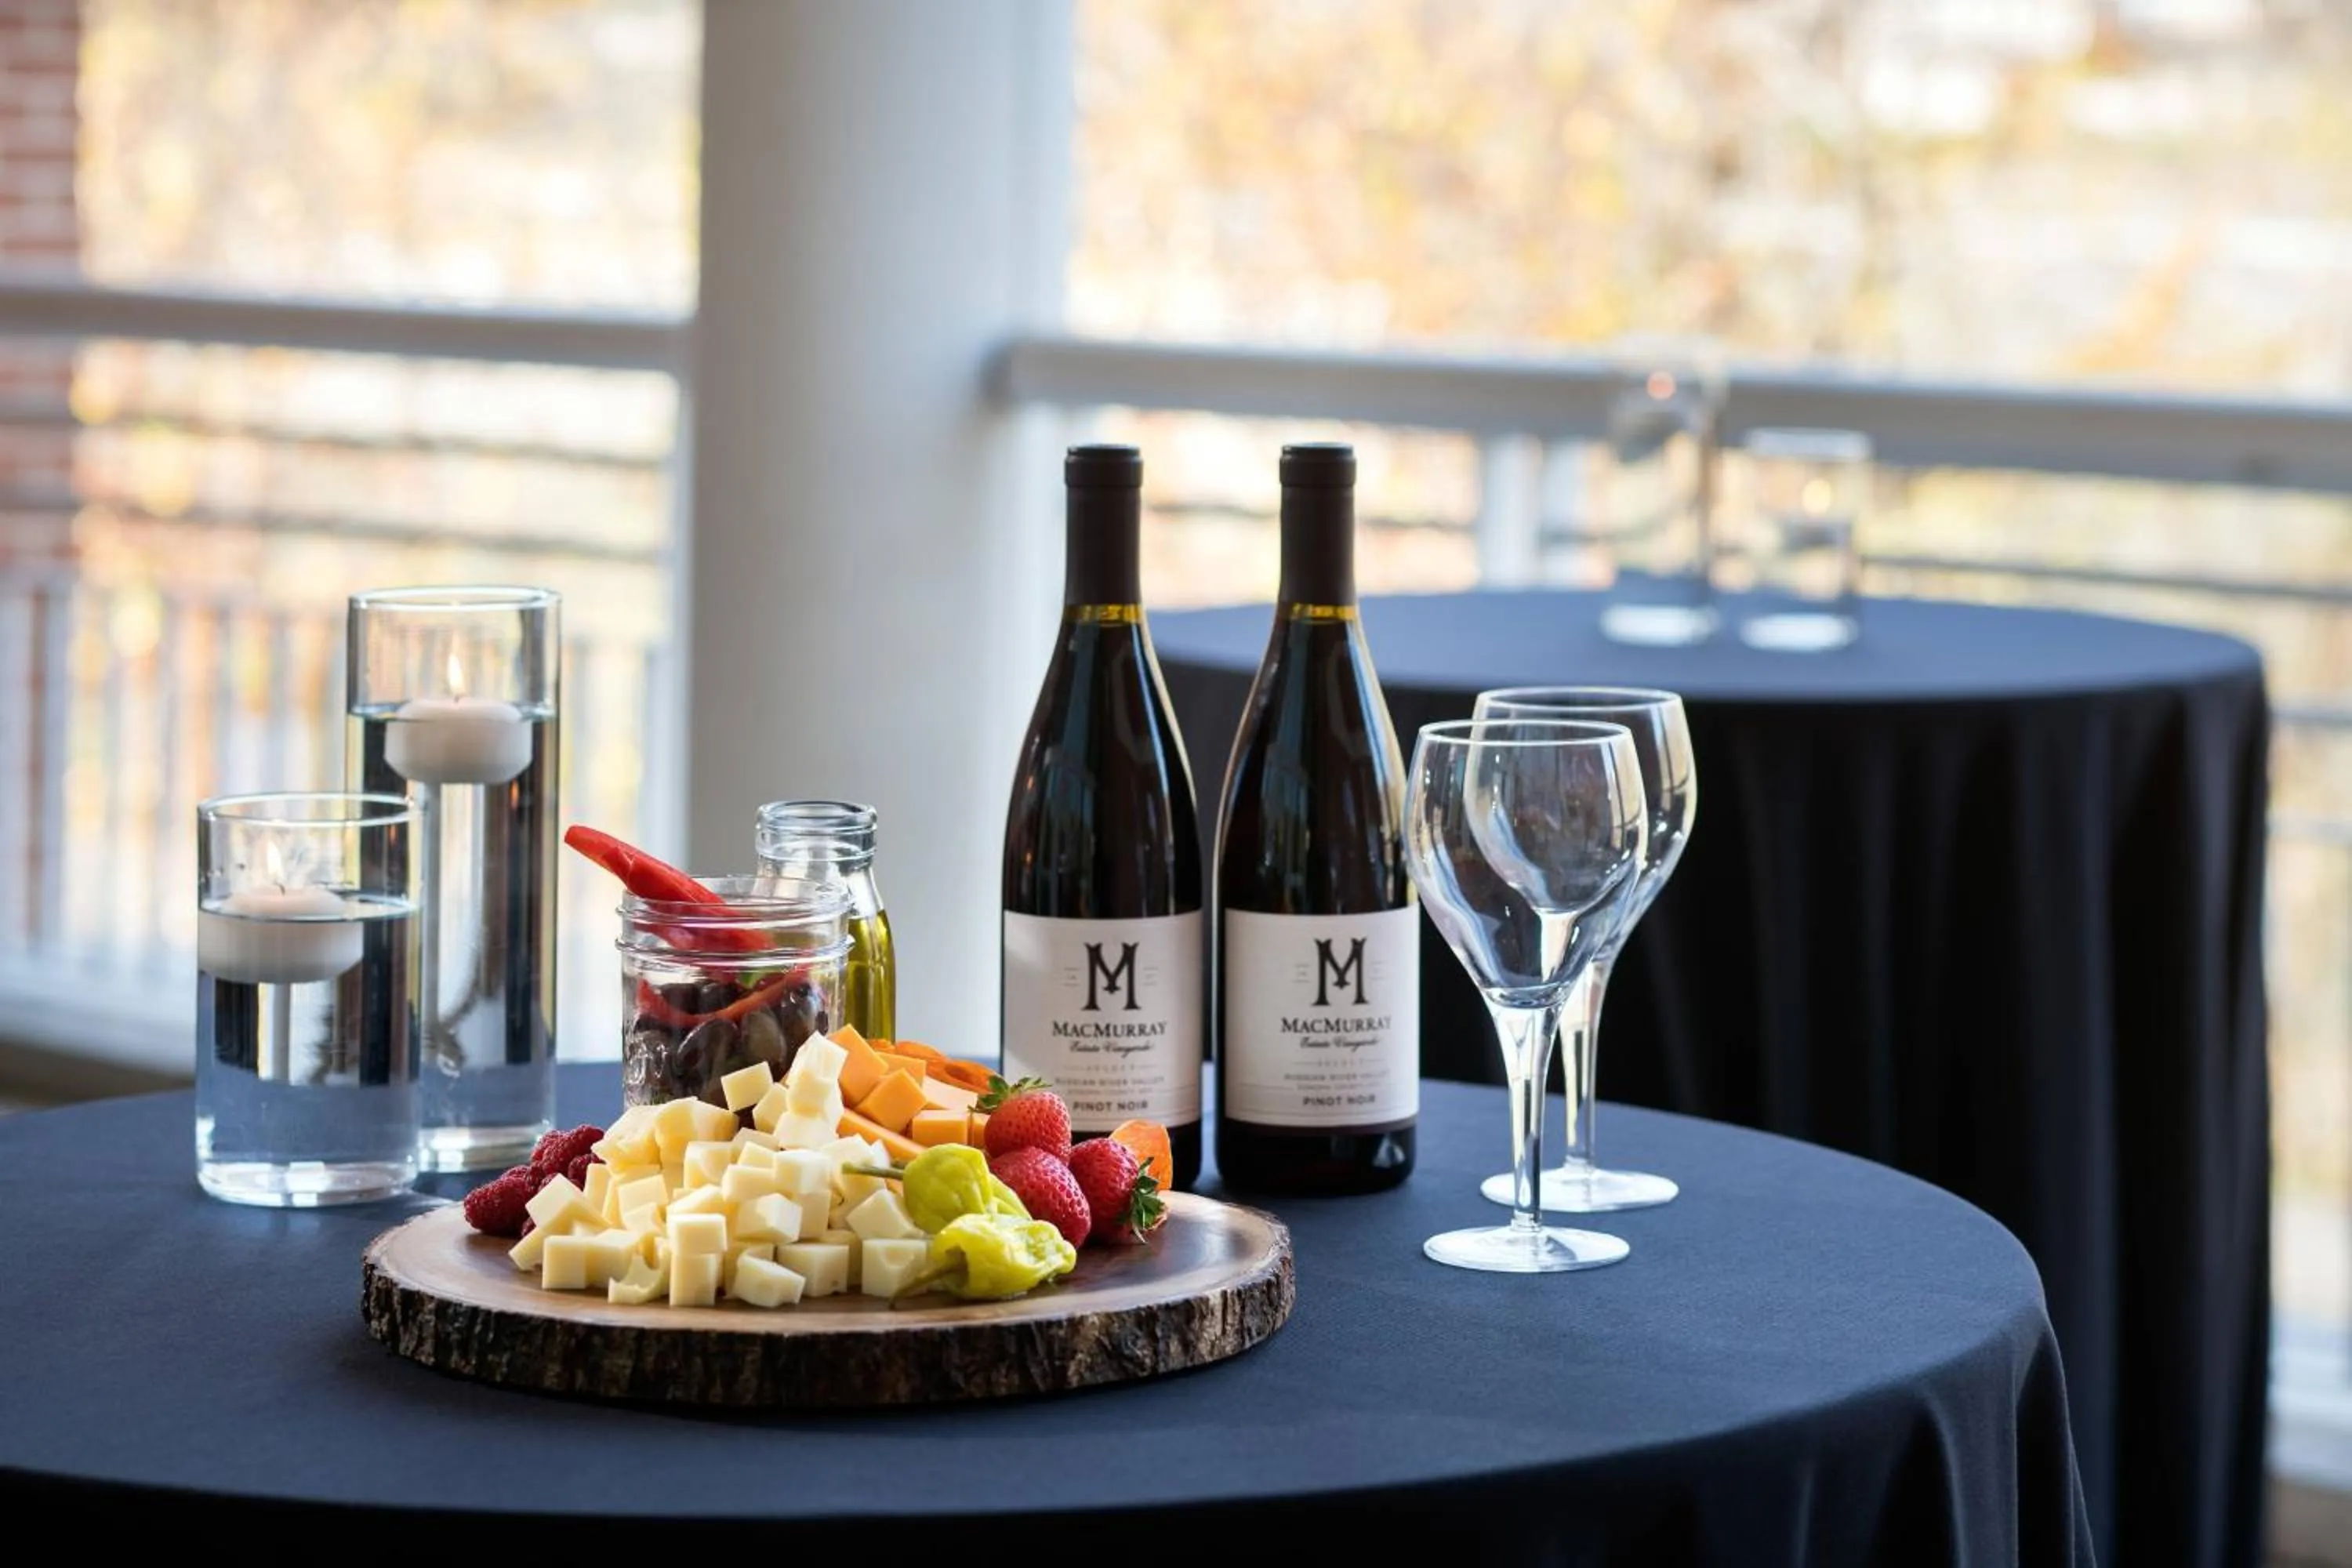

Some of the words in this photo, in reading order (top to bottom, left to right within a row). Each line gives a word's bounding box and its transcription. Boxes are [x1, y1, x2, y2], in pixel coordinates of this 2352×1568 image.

[1080, 942, 1142, 1011] M
[1310, 937, 1370, 1007] M
[1073, 1101, 1112, 1112] PINOT
[1116, 1100, 1149, 1111] NOIR
[1302, 1095, 1342, 1106] PINOT
